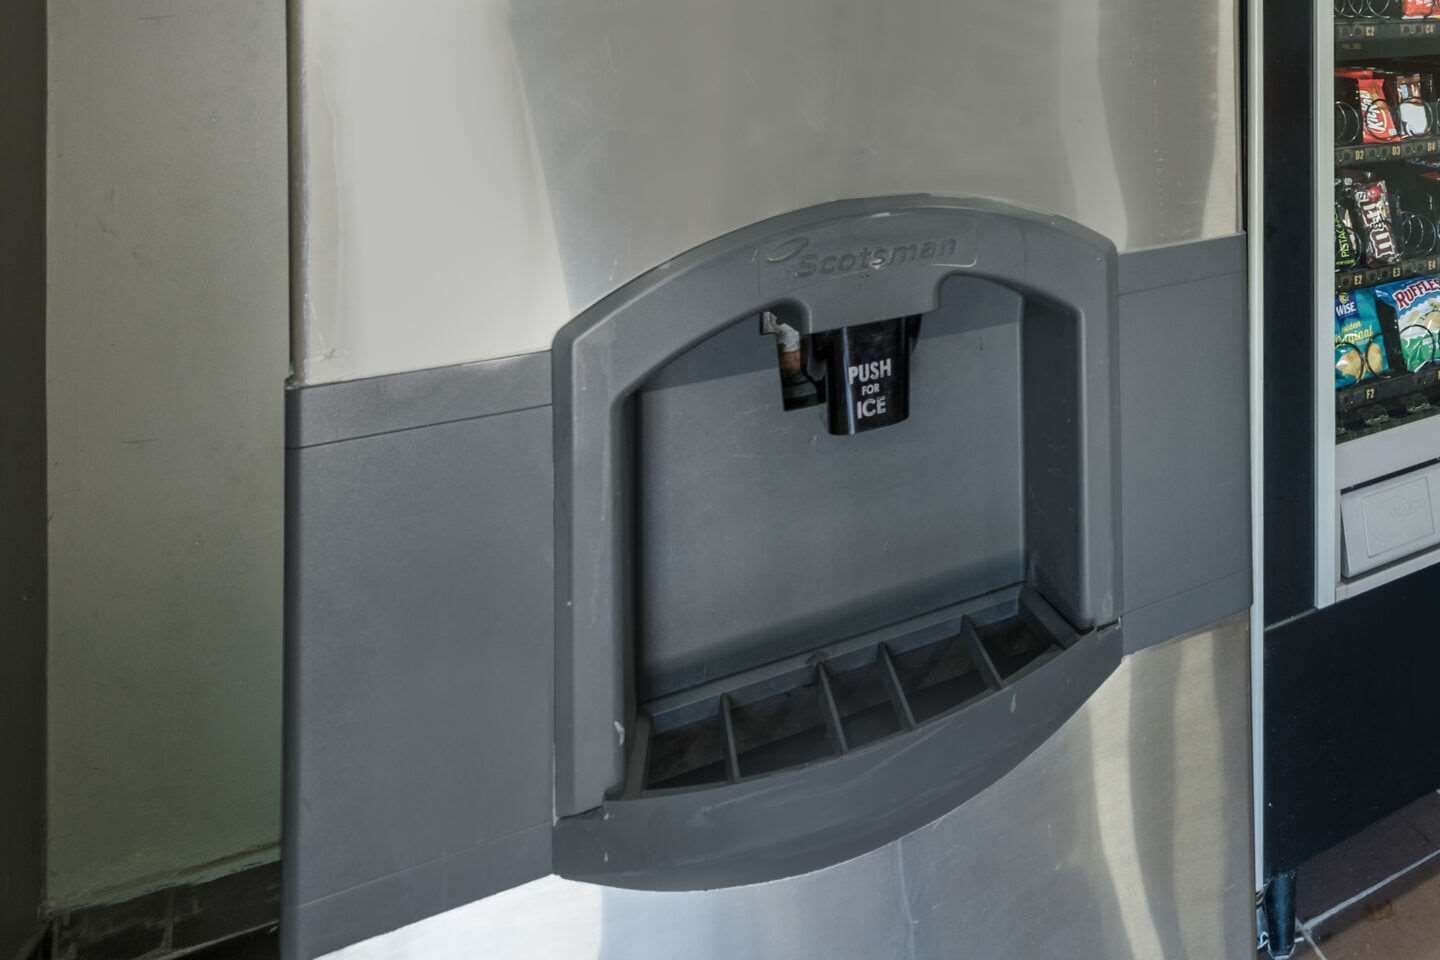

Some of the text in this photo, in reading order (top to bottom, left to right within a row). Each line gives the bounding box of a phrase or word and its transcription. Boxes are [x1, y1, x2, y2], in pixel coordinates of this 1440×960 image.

[794, 235, 957, 279] Scotsman
[1336, 302, 1357, 316] WISE
[848, 357, 892, 385] PUSH
[861, 383, 880, 396] FOR
[1366, 389, 1375, 400] F2
[856, 396, 887, 419] ICE
